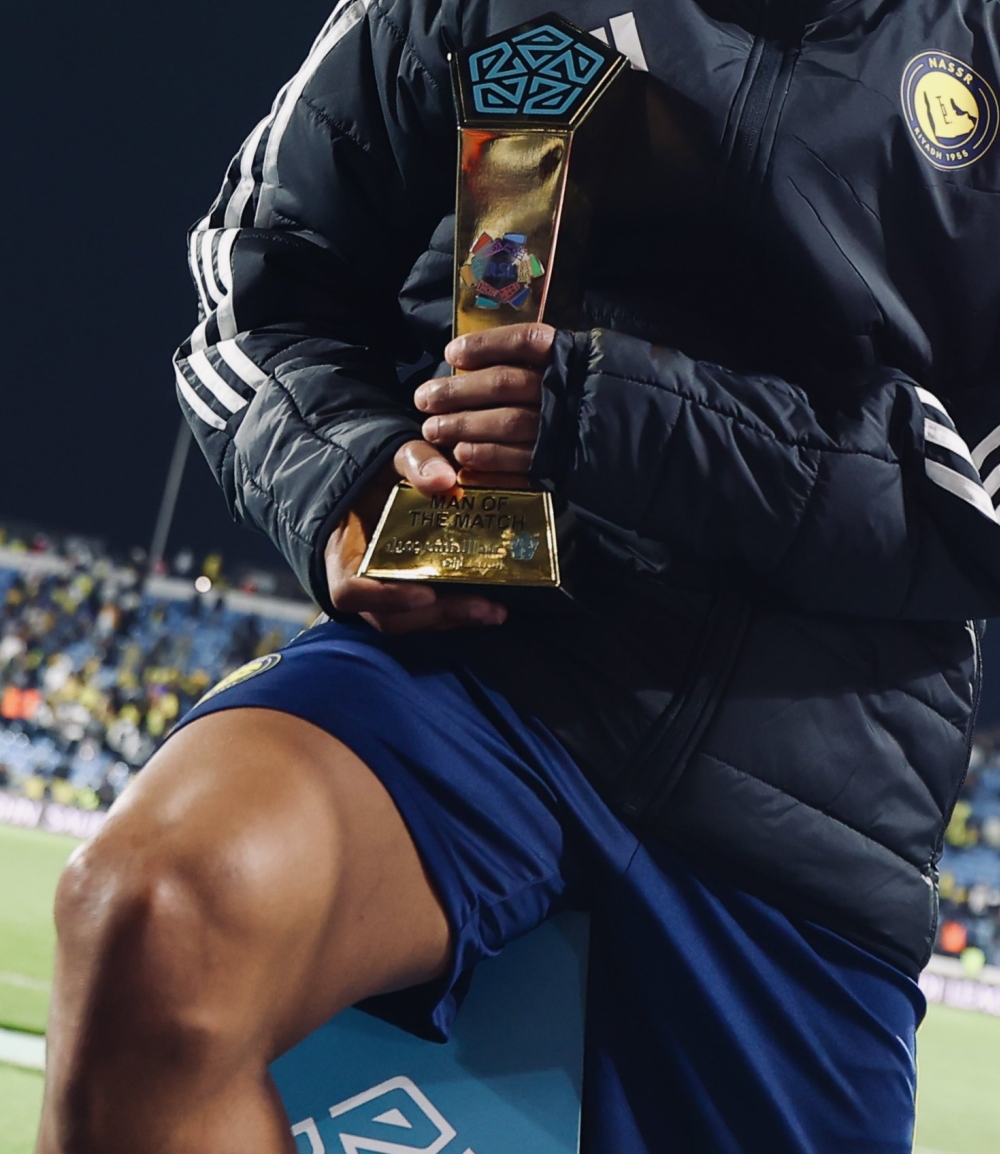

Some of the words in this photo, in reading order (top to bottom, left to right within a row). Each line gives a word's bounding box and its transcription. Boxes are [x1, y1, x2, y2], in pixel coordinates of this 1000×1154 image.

[927, 57, 974, 85] NASSR
[914, 127, 943, 159] RIYADH
[945, 149, 969, 161] 1955
[430, 495, 476, 511] MAN
[481, 496, 510, 512] OF
[410, 510, 449, 527] THE
[454, 513, 525, 530] MATCH
